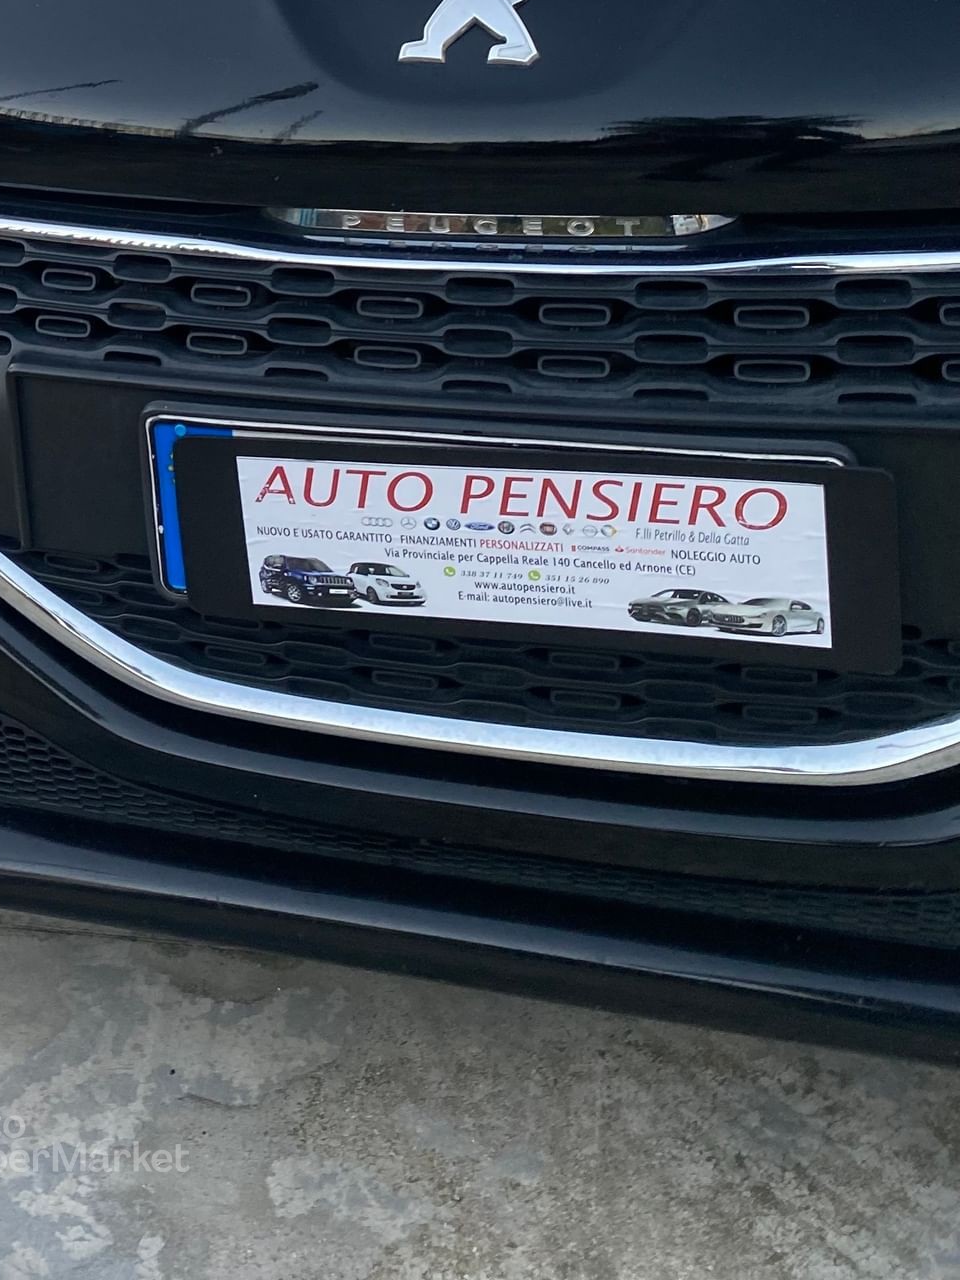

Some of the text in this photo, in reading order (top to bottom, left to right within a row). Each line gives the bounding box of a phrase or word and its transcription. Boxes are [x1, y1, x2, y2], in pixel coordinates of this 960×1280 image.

[341, 214, 640, 236] PEUGEOT
[255, 465, 788, 531] AUTO PENSIERO
[256, 526, 563, 552] NUOVO E USATO GARANTITO FINANZIAMENTI PERSONALIZZATI
[654, 529, 686, 543] Petrillo
[689, 531, 696, 543] &
[698, 532, 721, 545] Della
[724, 533, 750, 546] Gatta
[577, 544, 610, 552] COMPASS
[625, 546, 665, 556] Santander
[385, 548, 696, 577] Via Provinciale per Cappella Reale 140 Cancello ed Arnone (CE)
[670, 550, 761, 565] NOLEGGIO AUTO
[479, 571, 490, 579] 37
[545, 574, 561, 582] 351
[565, 575, 576, 583] 15
[474, 580, 576, 595] www.autopensiero.it
[458, 591, 593, 608] E-mail: autopensiero@live.it
